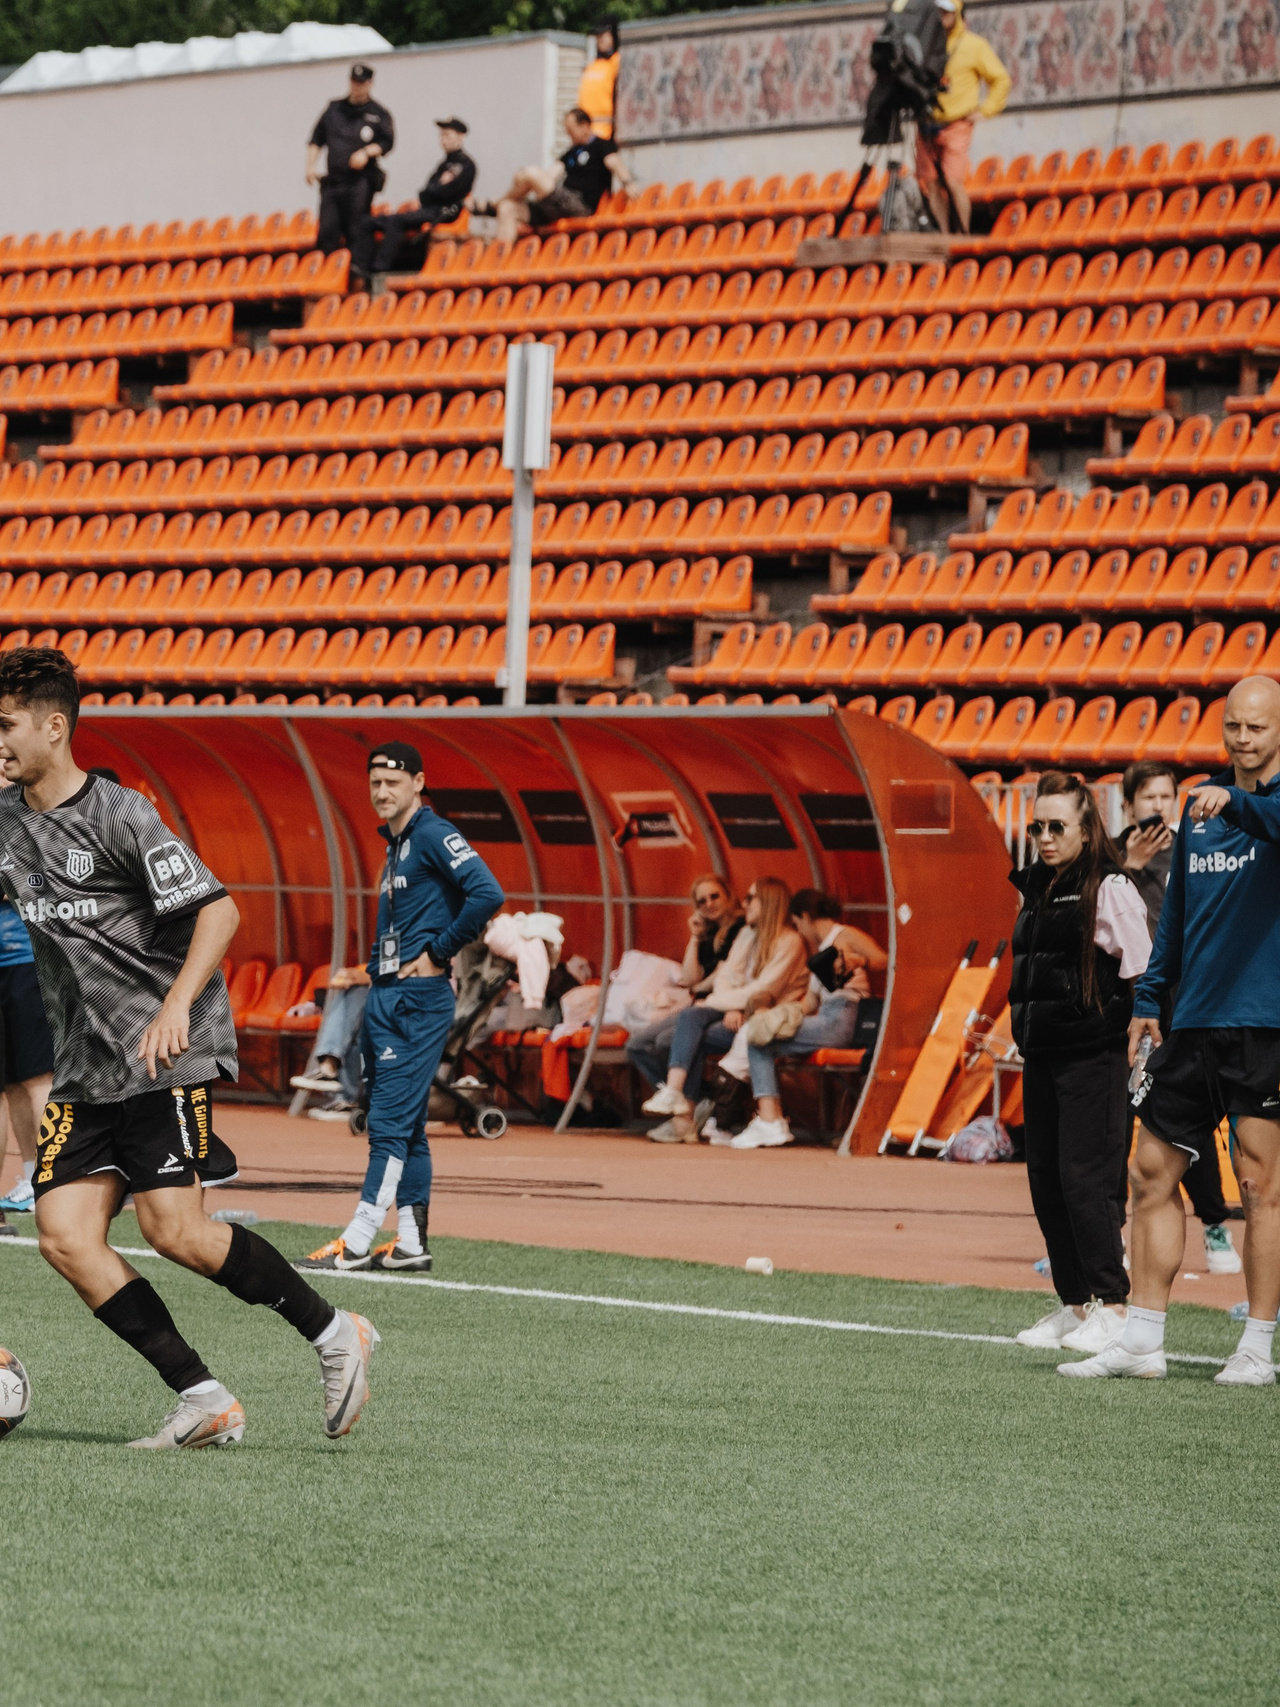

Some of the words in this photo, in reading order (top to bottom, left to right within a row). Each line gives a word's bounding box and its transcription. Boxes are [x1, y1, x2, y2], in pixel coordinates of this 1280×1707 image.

[154, 854, 186, 882] BB
[1189, 847, 1256, 874] BetBo
[154, 882, 209, 911] BetBoom
[190, 1087, 207, 1104] НЕ
[37, 1103, 74, 1184] BetBoom
[194, 1105, 208, 1159] СЛОМАТЬ
[157, 1165, 185, 1174] DEMIX
